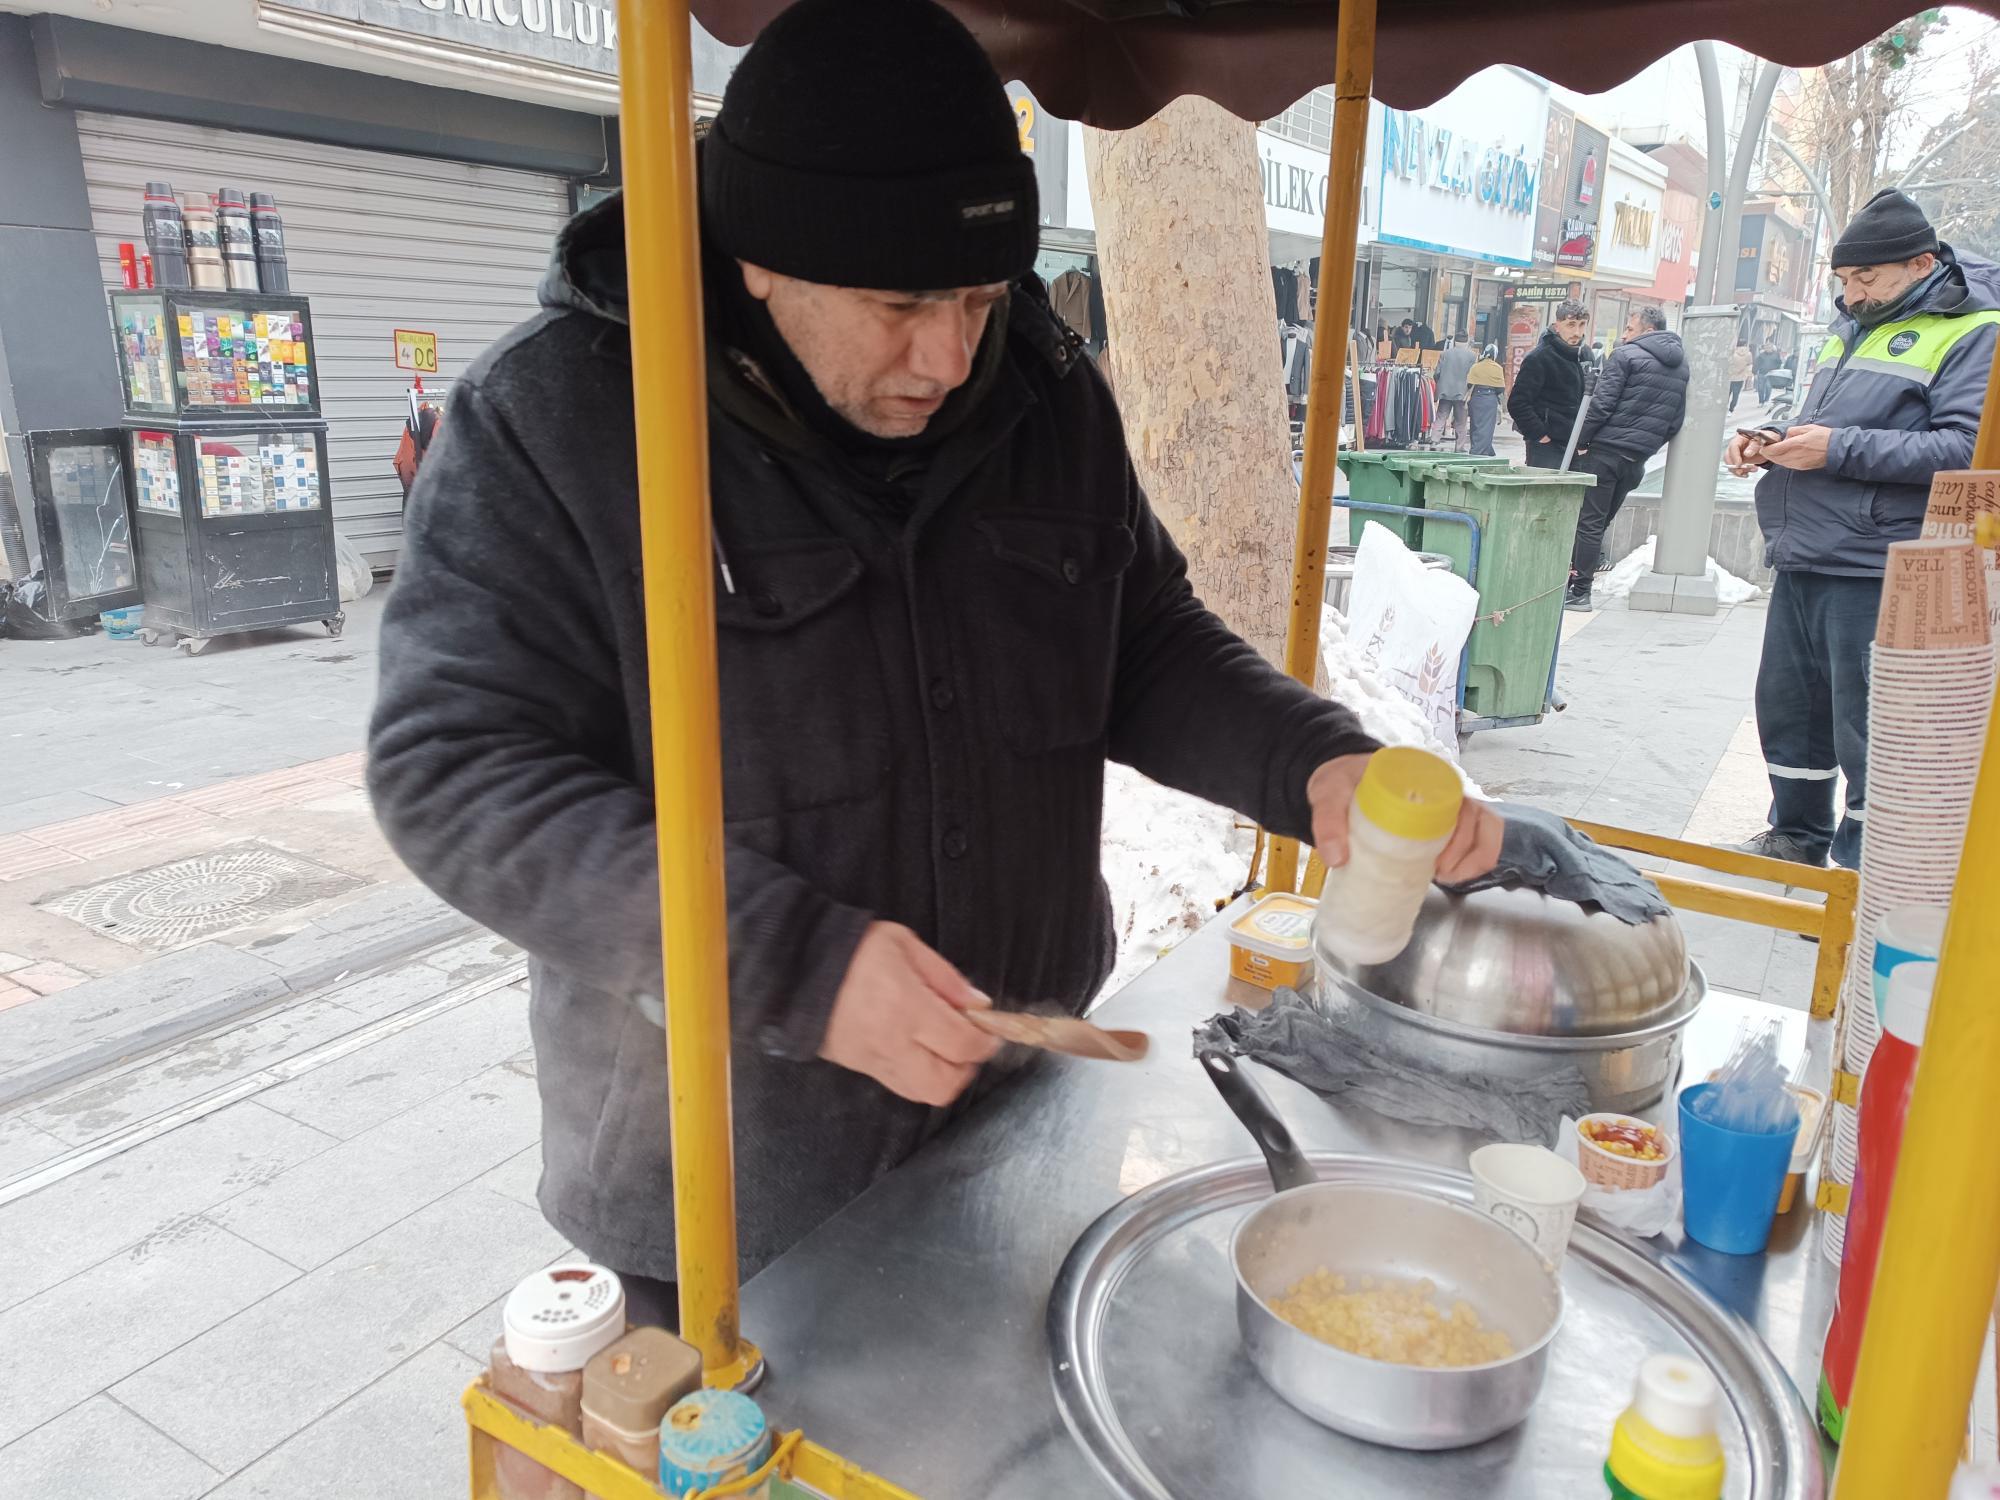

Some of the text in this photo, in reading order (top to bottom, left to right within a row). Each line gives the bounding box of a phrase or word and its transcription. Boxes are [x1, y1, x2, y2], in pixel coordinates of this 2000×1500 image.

[1903, 559, 1945, 573] TEA
[1964, 548, 1978, 606] MOCHA
[1930, 625, 1969, 635] LATTE
